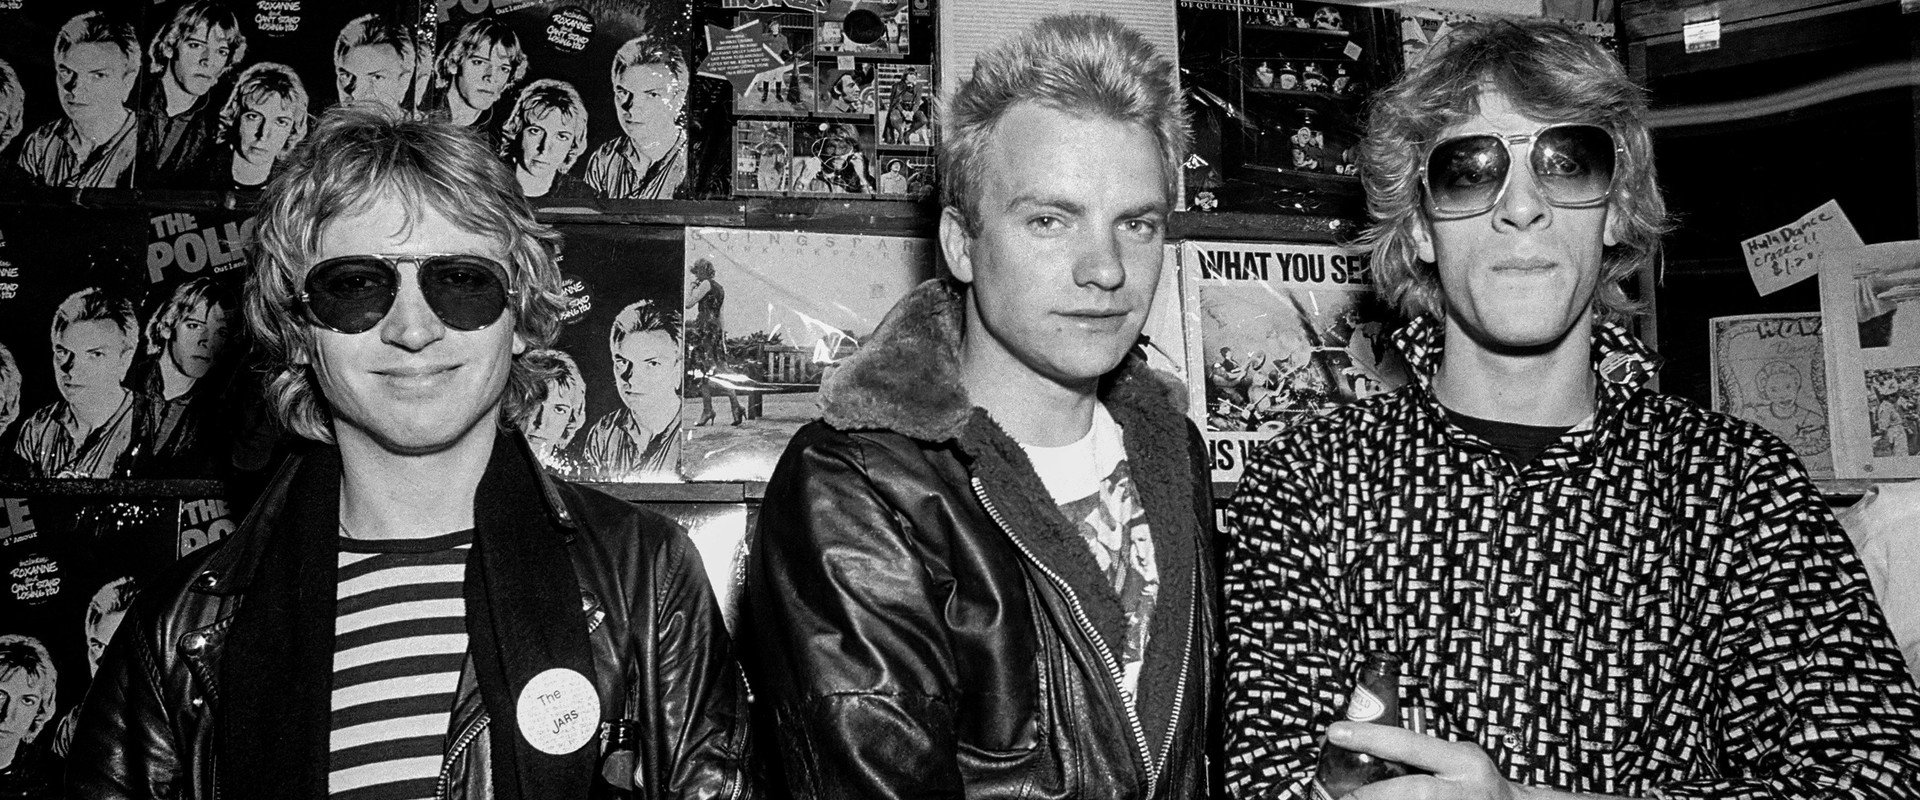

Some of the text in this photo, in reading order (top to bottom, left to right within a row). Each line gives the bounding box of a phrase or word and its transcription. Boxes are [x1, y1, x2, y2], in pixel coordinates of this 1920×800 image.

[552, 14, 593, 33] ROXANNE
[150, 212, 198, 239] THE
[1780, 211, 1834, 242] Dance
[1197, 250, 1272, 281] WHAT
[1275, 252, 1326, 284] YOU
[9, 560, 59, 579] ROXANNE
[536, 689, 561, 706] The
[552, 709, 579, 735] JARS
